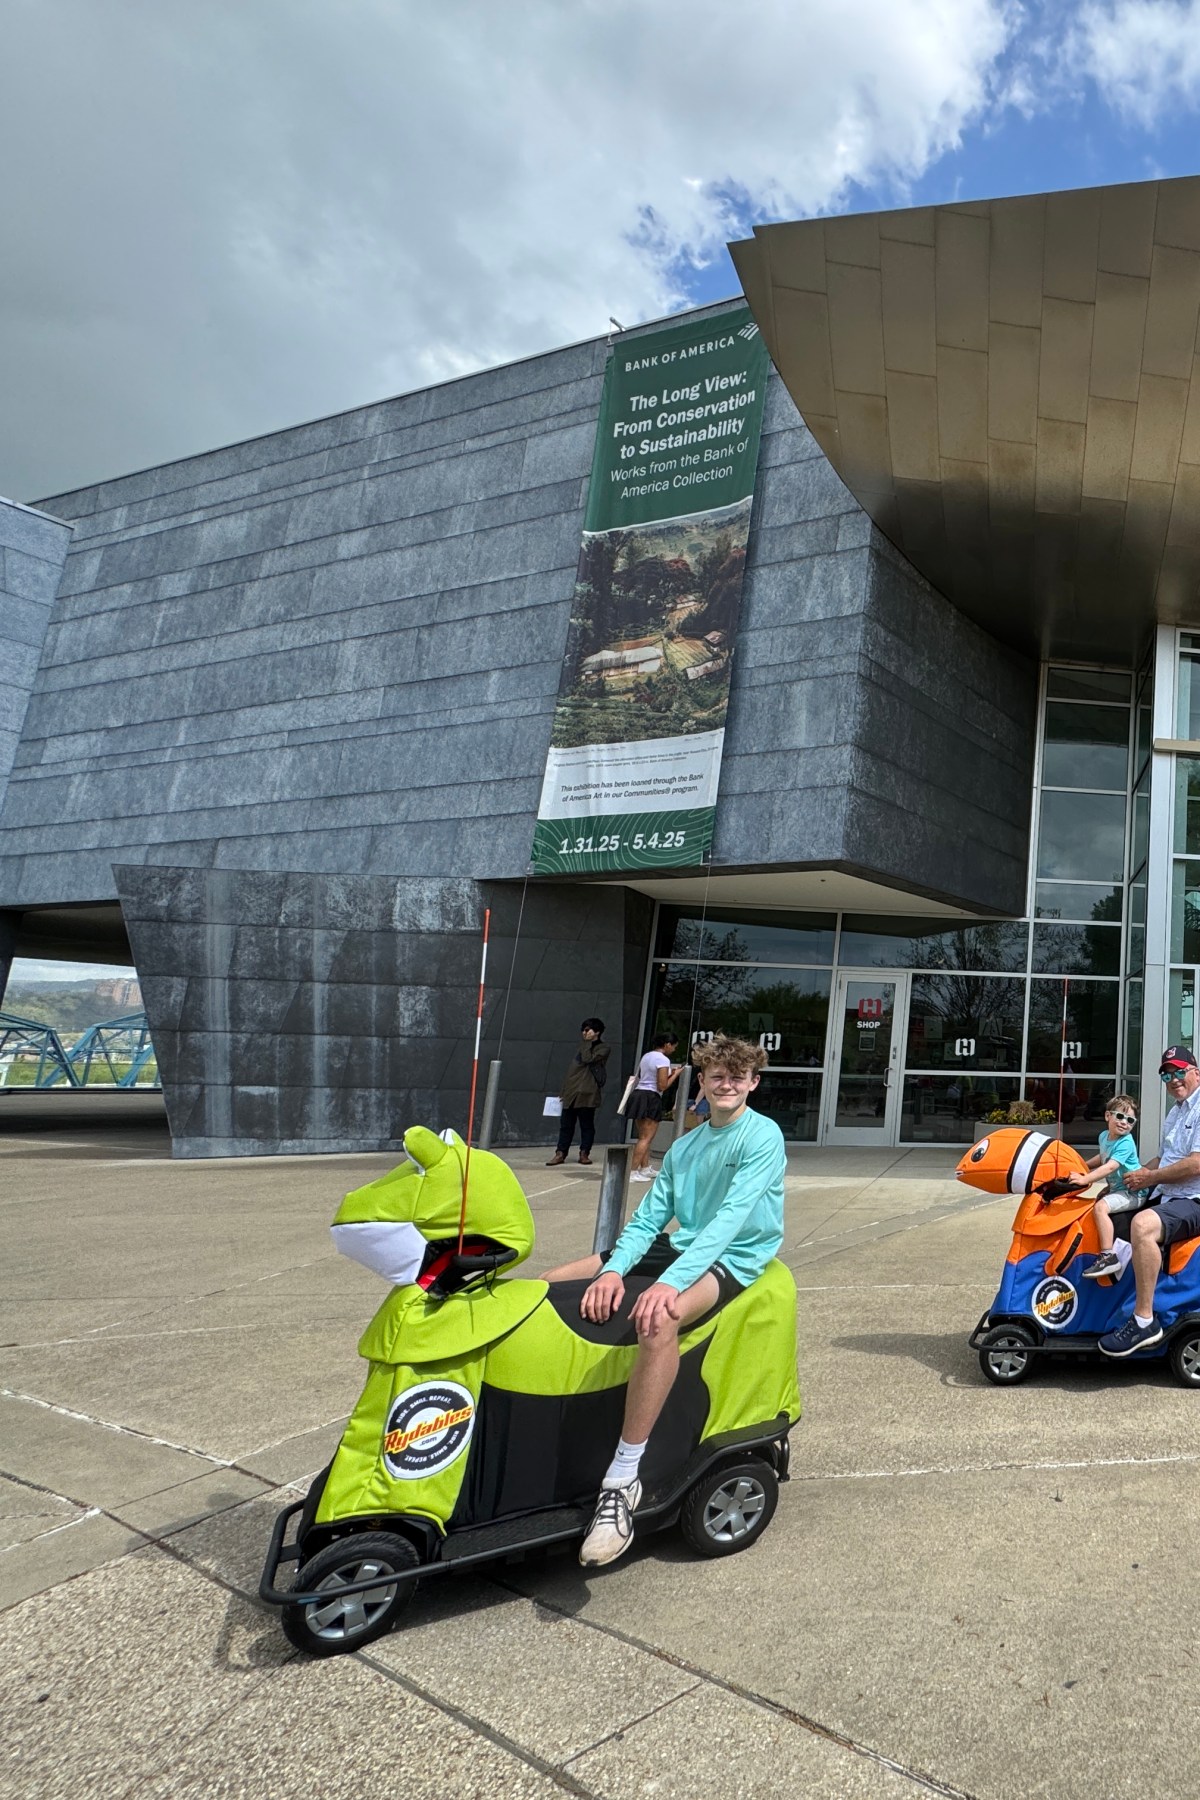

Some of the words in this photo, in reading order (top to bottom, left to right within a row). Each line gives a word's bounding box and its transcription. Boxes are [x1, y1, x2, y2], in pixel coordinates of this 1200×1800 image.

[625, 356, 658, 372] BANK
[661, 352, 676, 364] OF
[679, 336, 735, 360] AMERICA
[629, 395, 657, 412] The
[662, 382, 701, 405] Long
[705, 371, 748, 393] View:
[613, 419, 652, 438] From
[656, 390, 756, 428] Conservation
[620, 444, 635, 459] to
[639, 417, 745, 455] Sustainability
[610, 465, 646, 482] Works
[650, 459, 677, 474] from
[680, 454, 700, 467] the
[703, 444, 734, 462] Bank
[737, 437, 750, 453] of
[620, 480, 669, 499] America
[673, 465, 733, 489] Collection
[569, 793, 592, 802] America
[593, 792, 602, 800] Art
[631, 778, 653, 786] loaned
[653, 776, 677, 785] through
[689, 773, 704, 781] Bank
[559, 835, 620, 854] 1.31.25
[632, 831, 686, 850] 5.4.25
[857, 1021, 881, 1029] SHOP
[384, 1405, 474, 1454] Rydables
